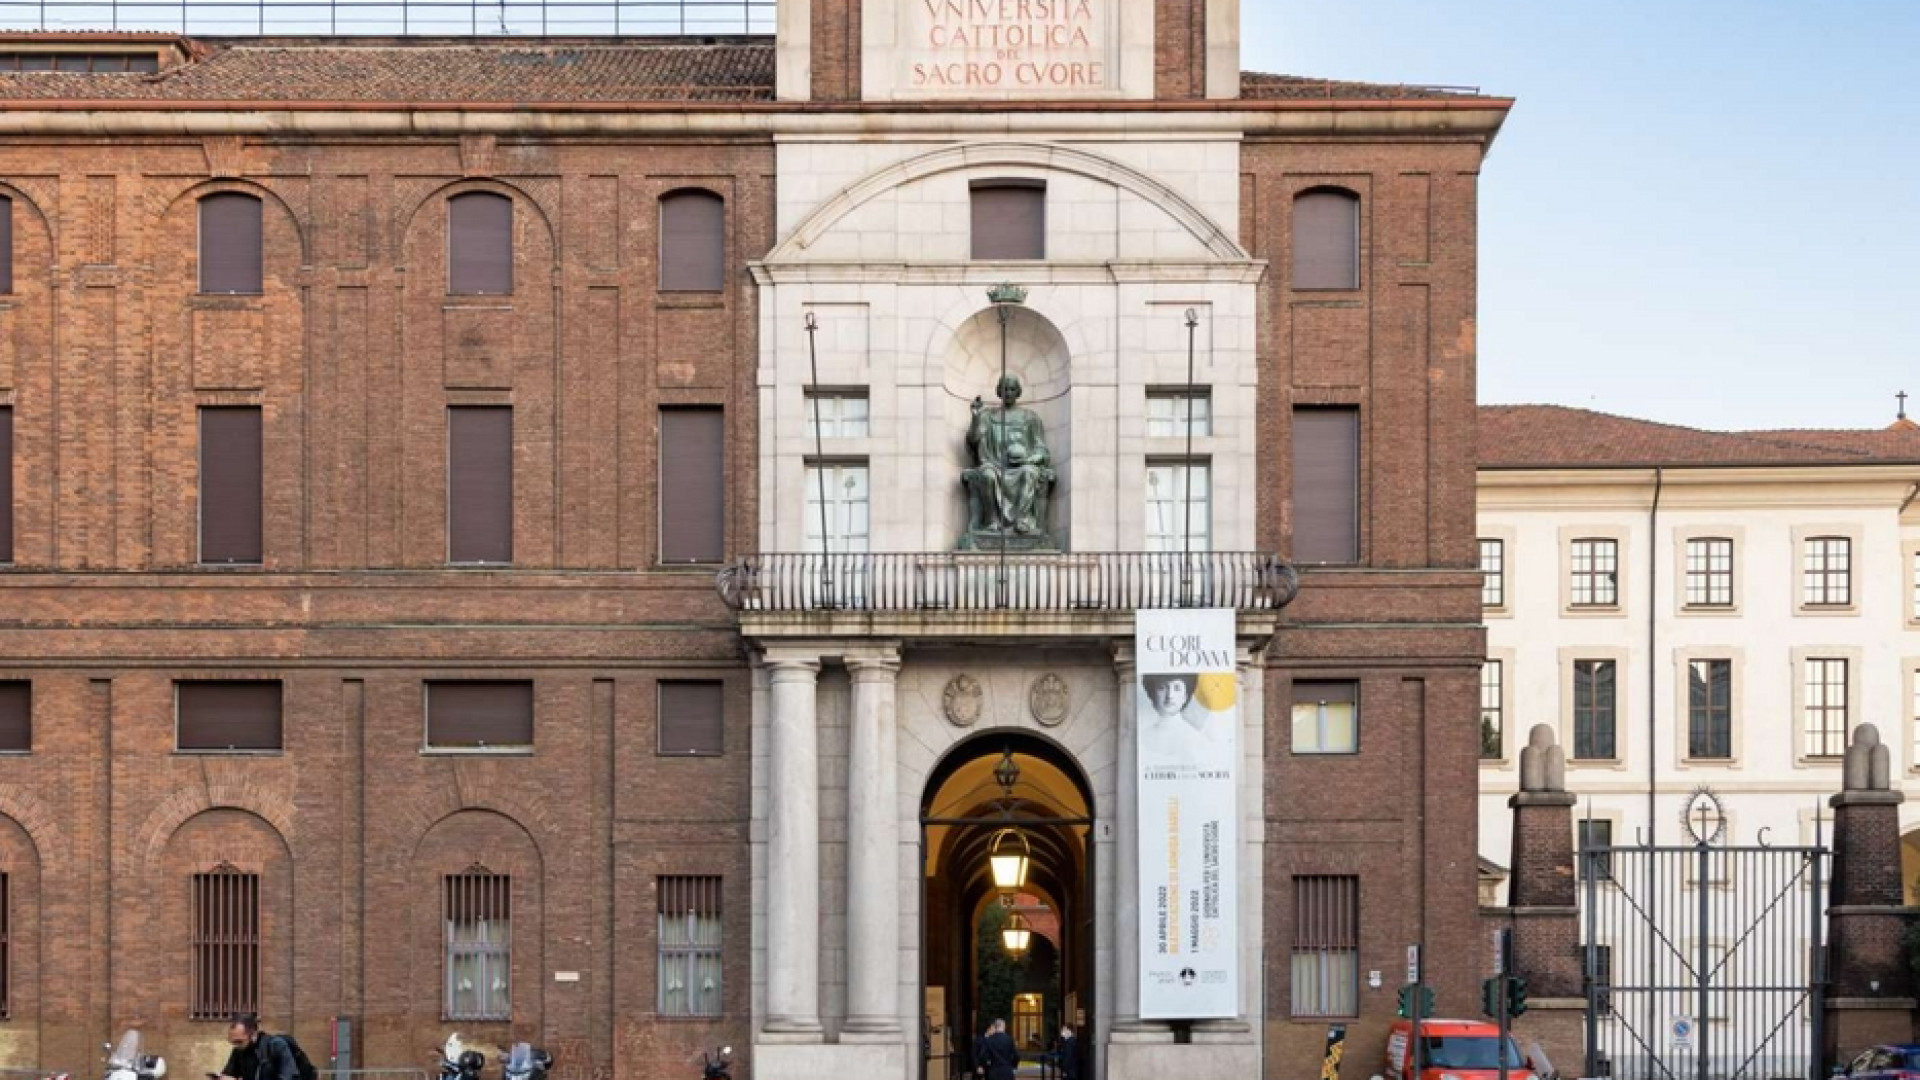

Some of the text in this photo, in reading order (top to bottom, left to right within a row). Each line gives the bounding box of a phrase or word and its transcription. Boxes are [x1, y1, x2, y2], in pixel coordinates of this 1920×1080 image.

[930, 24, 1089, 47] CATTOLICA
[913, 62, 1103, 85] SACRO CVORE
